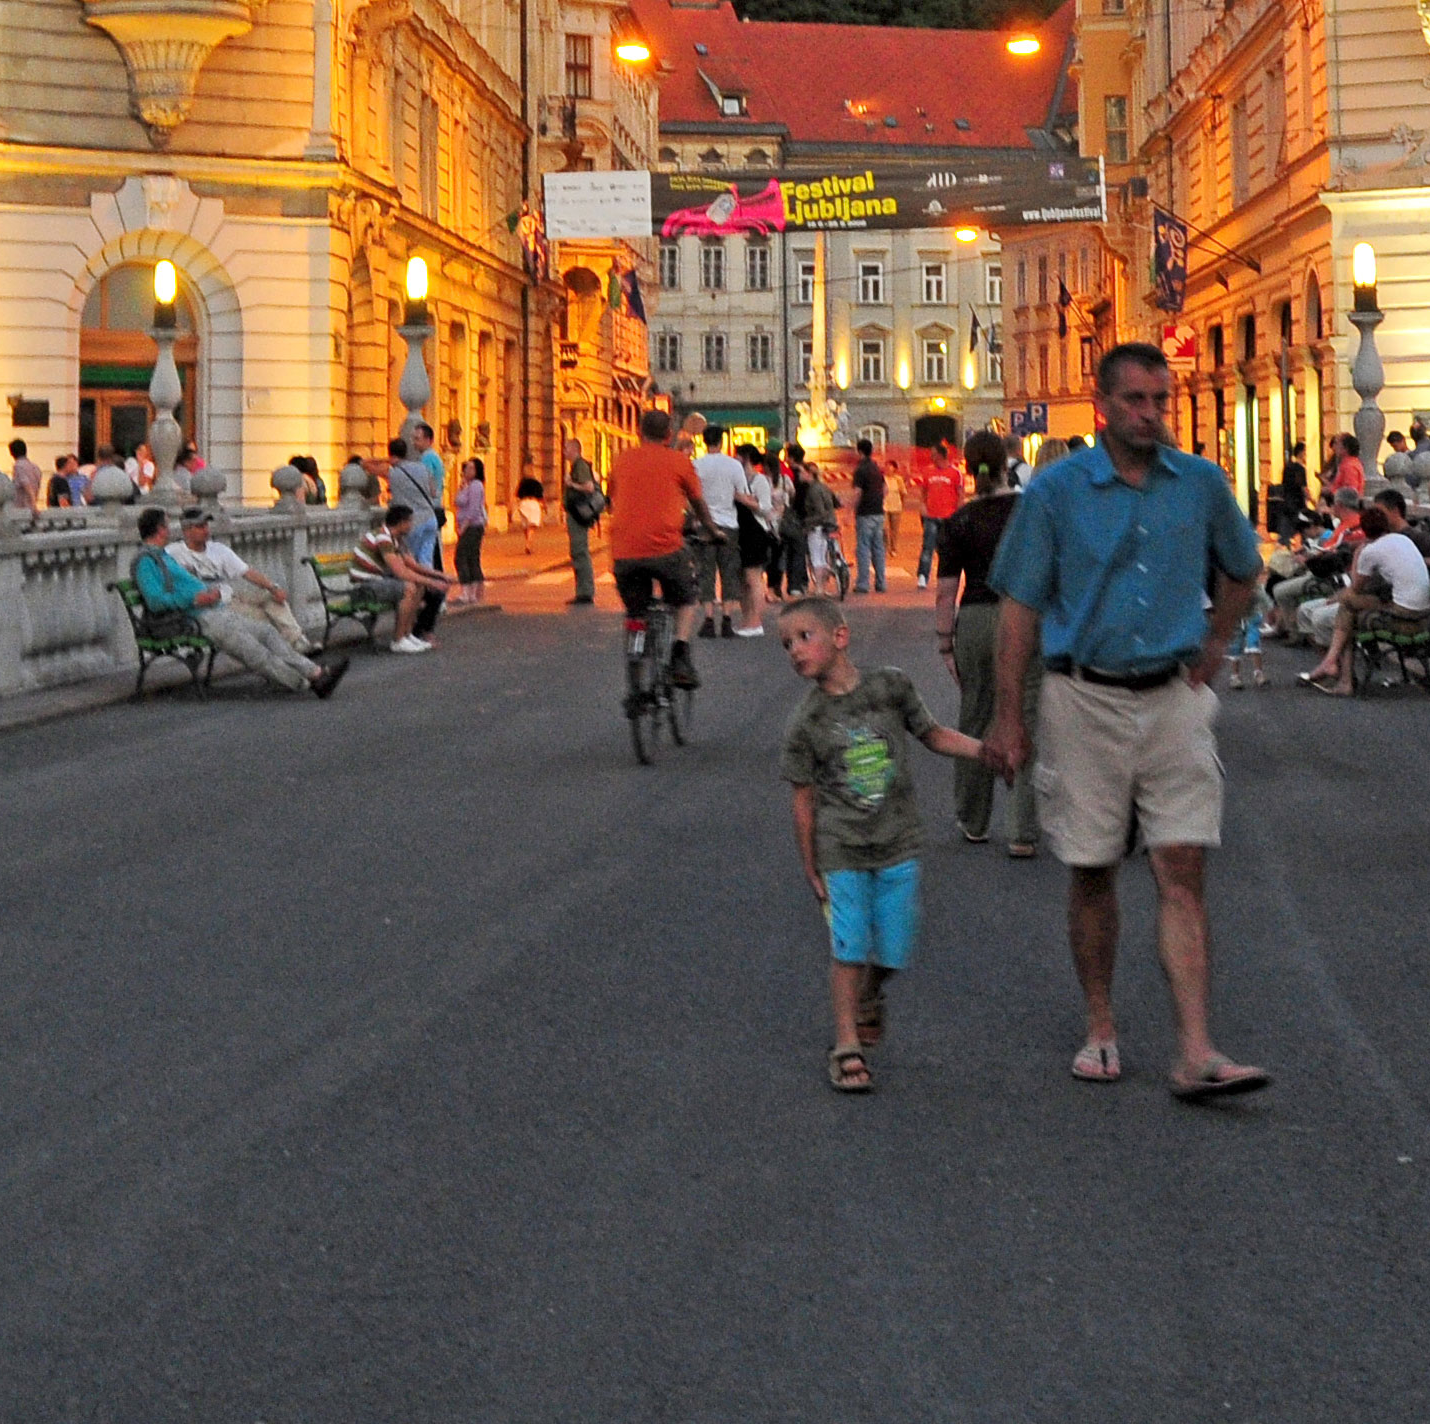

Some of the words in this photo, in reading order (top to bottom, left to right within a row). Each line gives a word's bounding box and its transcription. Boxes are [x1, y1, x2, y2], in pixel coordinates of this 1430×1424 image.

[779, 170, 875, 202] Festival
[782, 196, 897, 226] Ljubljana
[1014, 413, 1025, 427] P
[1031, 404, 1043, 422] P
